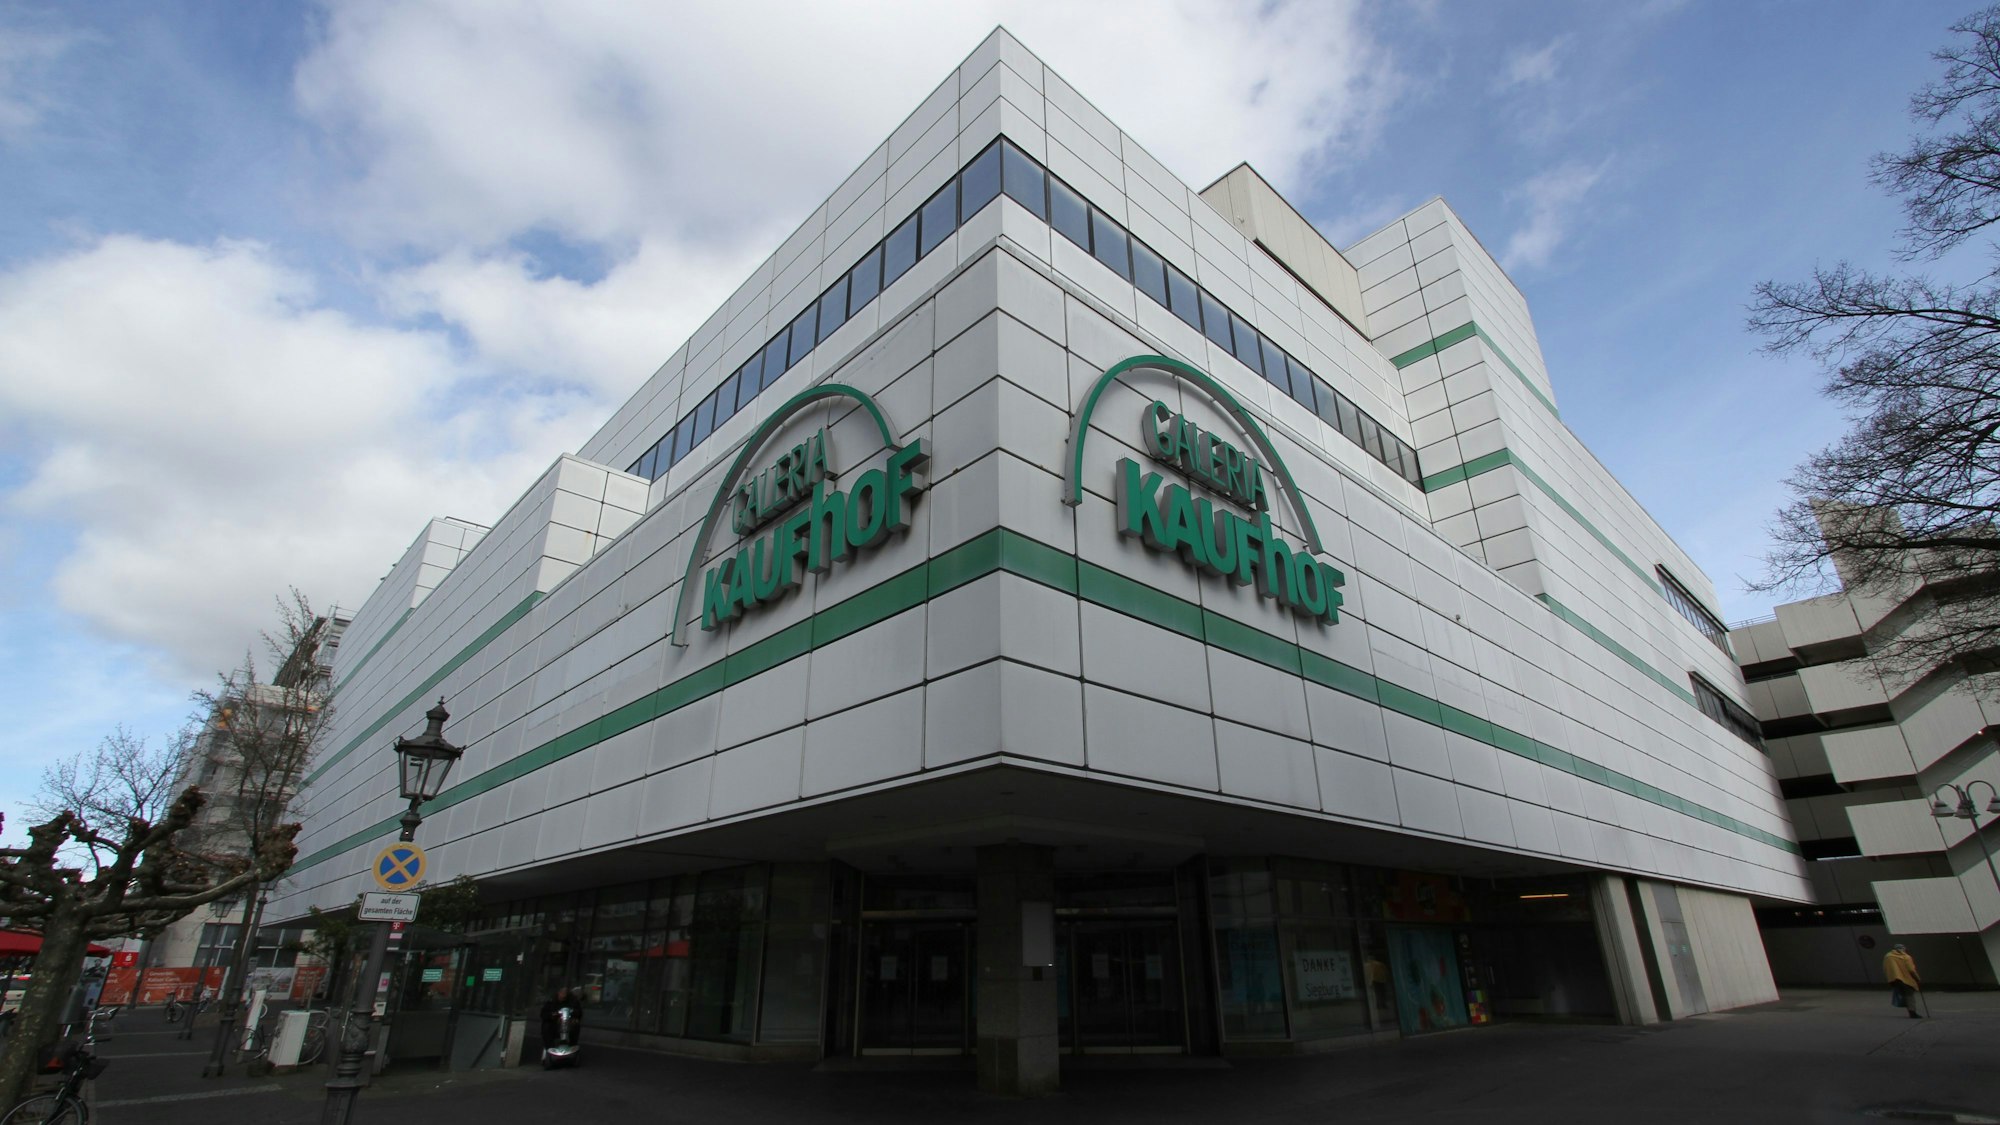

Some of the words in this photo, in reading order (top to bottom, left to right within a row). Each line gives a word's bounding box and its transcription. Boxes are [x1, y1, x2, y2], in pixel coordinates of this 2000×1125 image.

[1142, 400, 1269, 512] GALERIA
[732, 427, 838, 536] GALERIA
[381, 897, 392, 905] auf
[392, 897, 402, 905] der
[365, 907, 393, 915] gesamten
[394, 907, 413, 915] Fläche
[1302, 958, 1335, 972] DANKE
